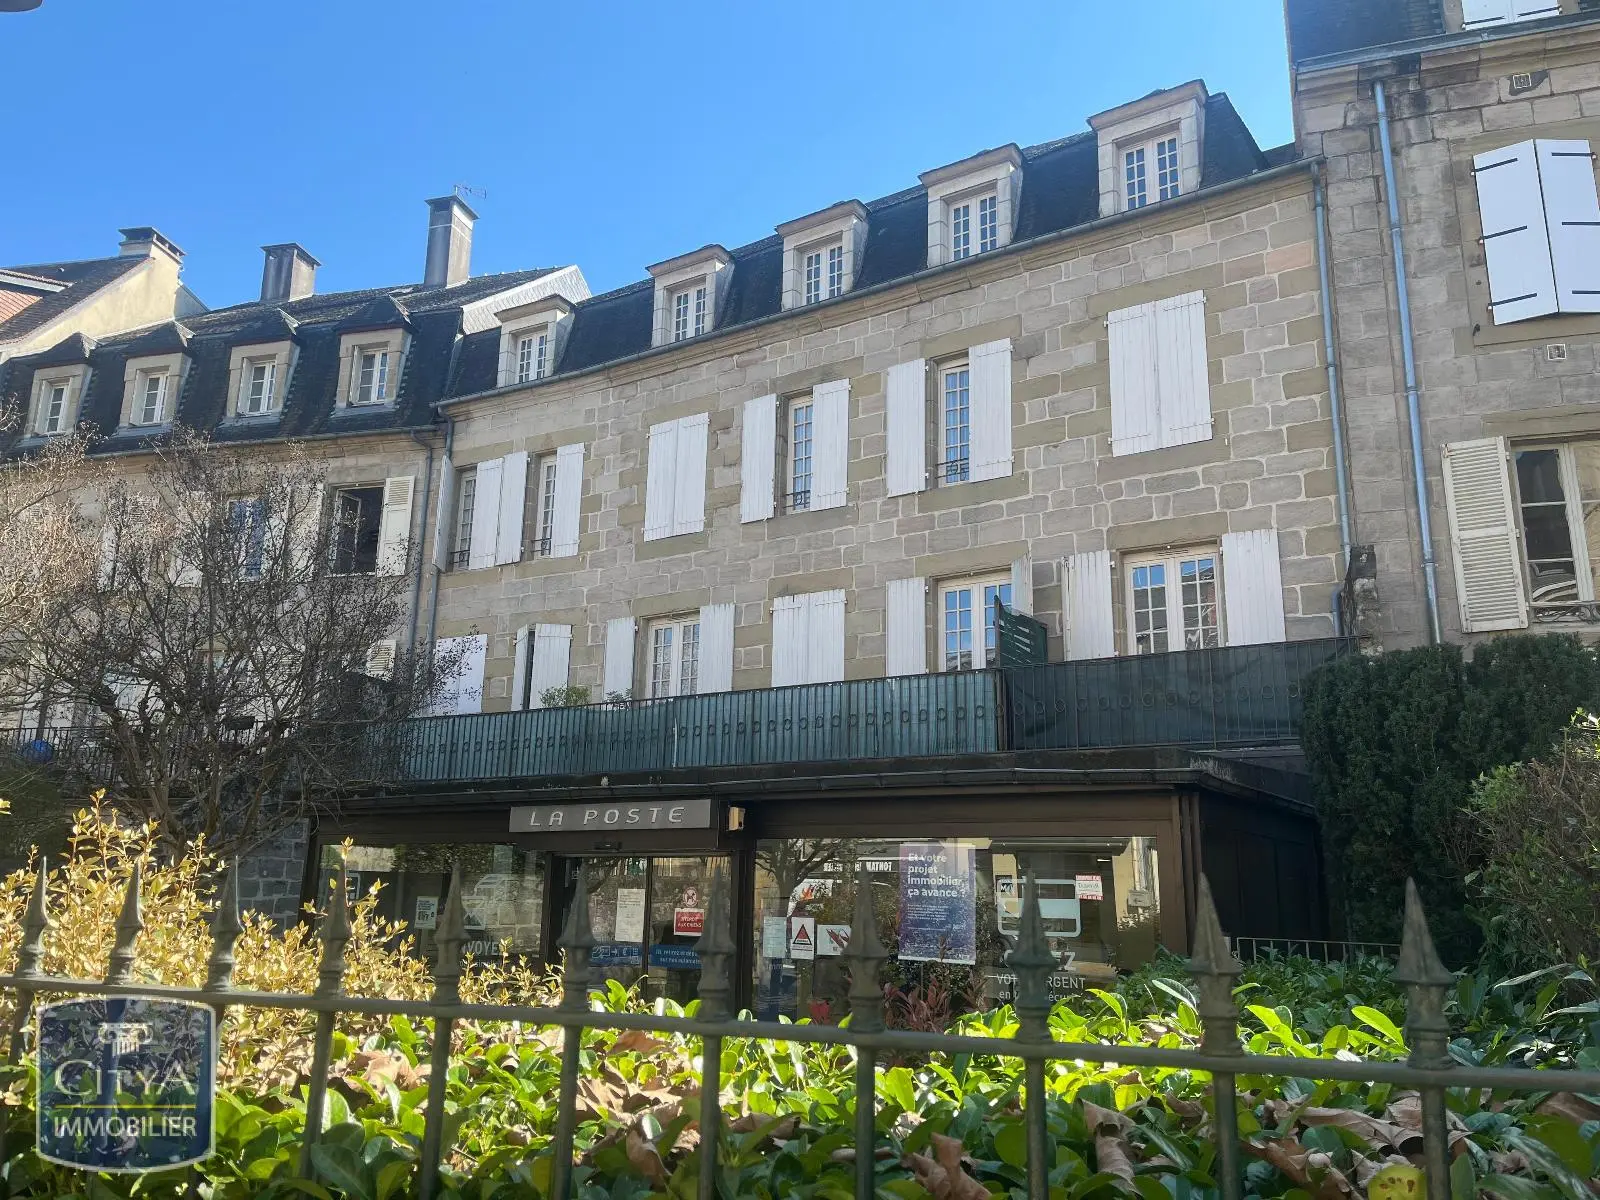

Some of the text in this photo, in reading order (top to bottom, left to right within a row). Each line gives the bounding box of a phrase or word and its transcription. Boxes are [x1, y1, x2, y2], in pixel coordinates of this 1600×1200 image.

[530, 806, 685, 826] LA POSTE
[919, 854, 947, 863] votre
[908, 864, 938, 875] projet
[907, 888, 966, 898] ça avance ?
